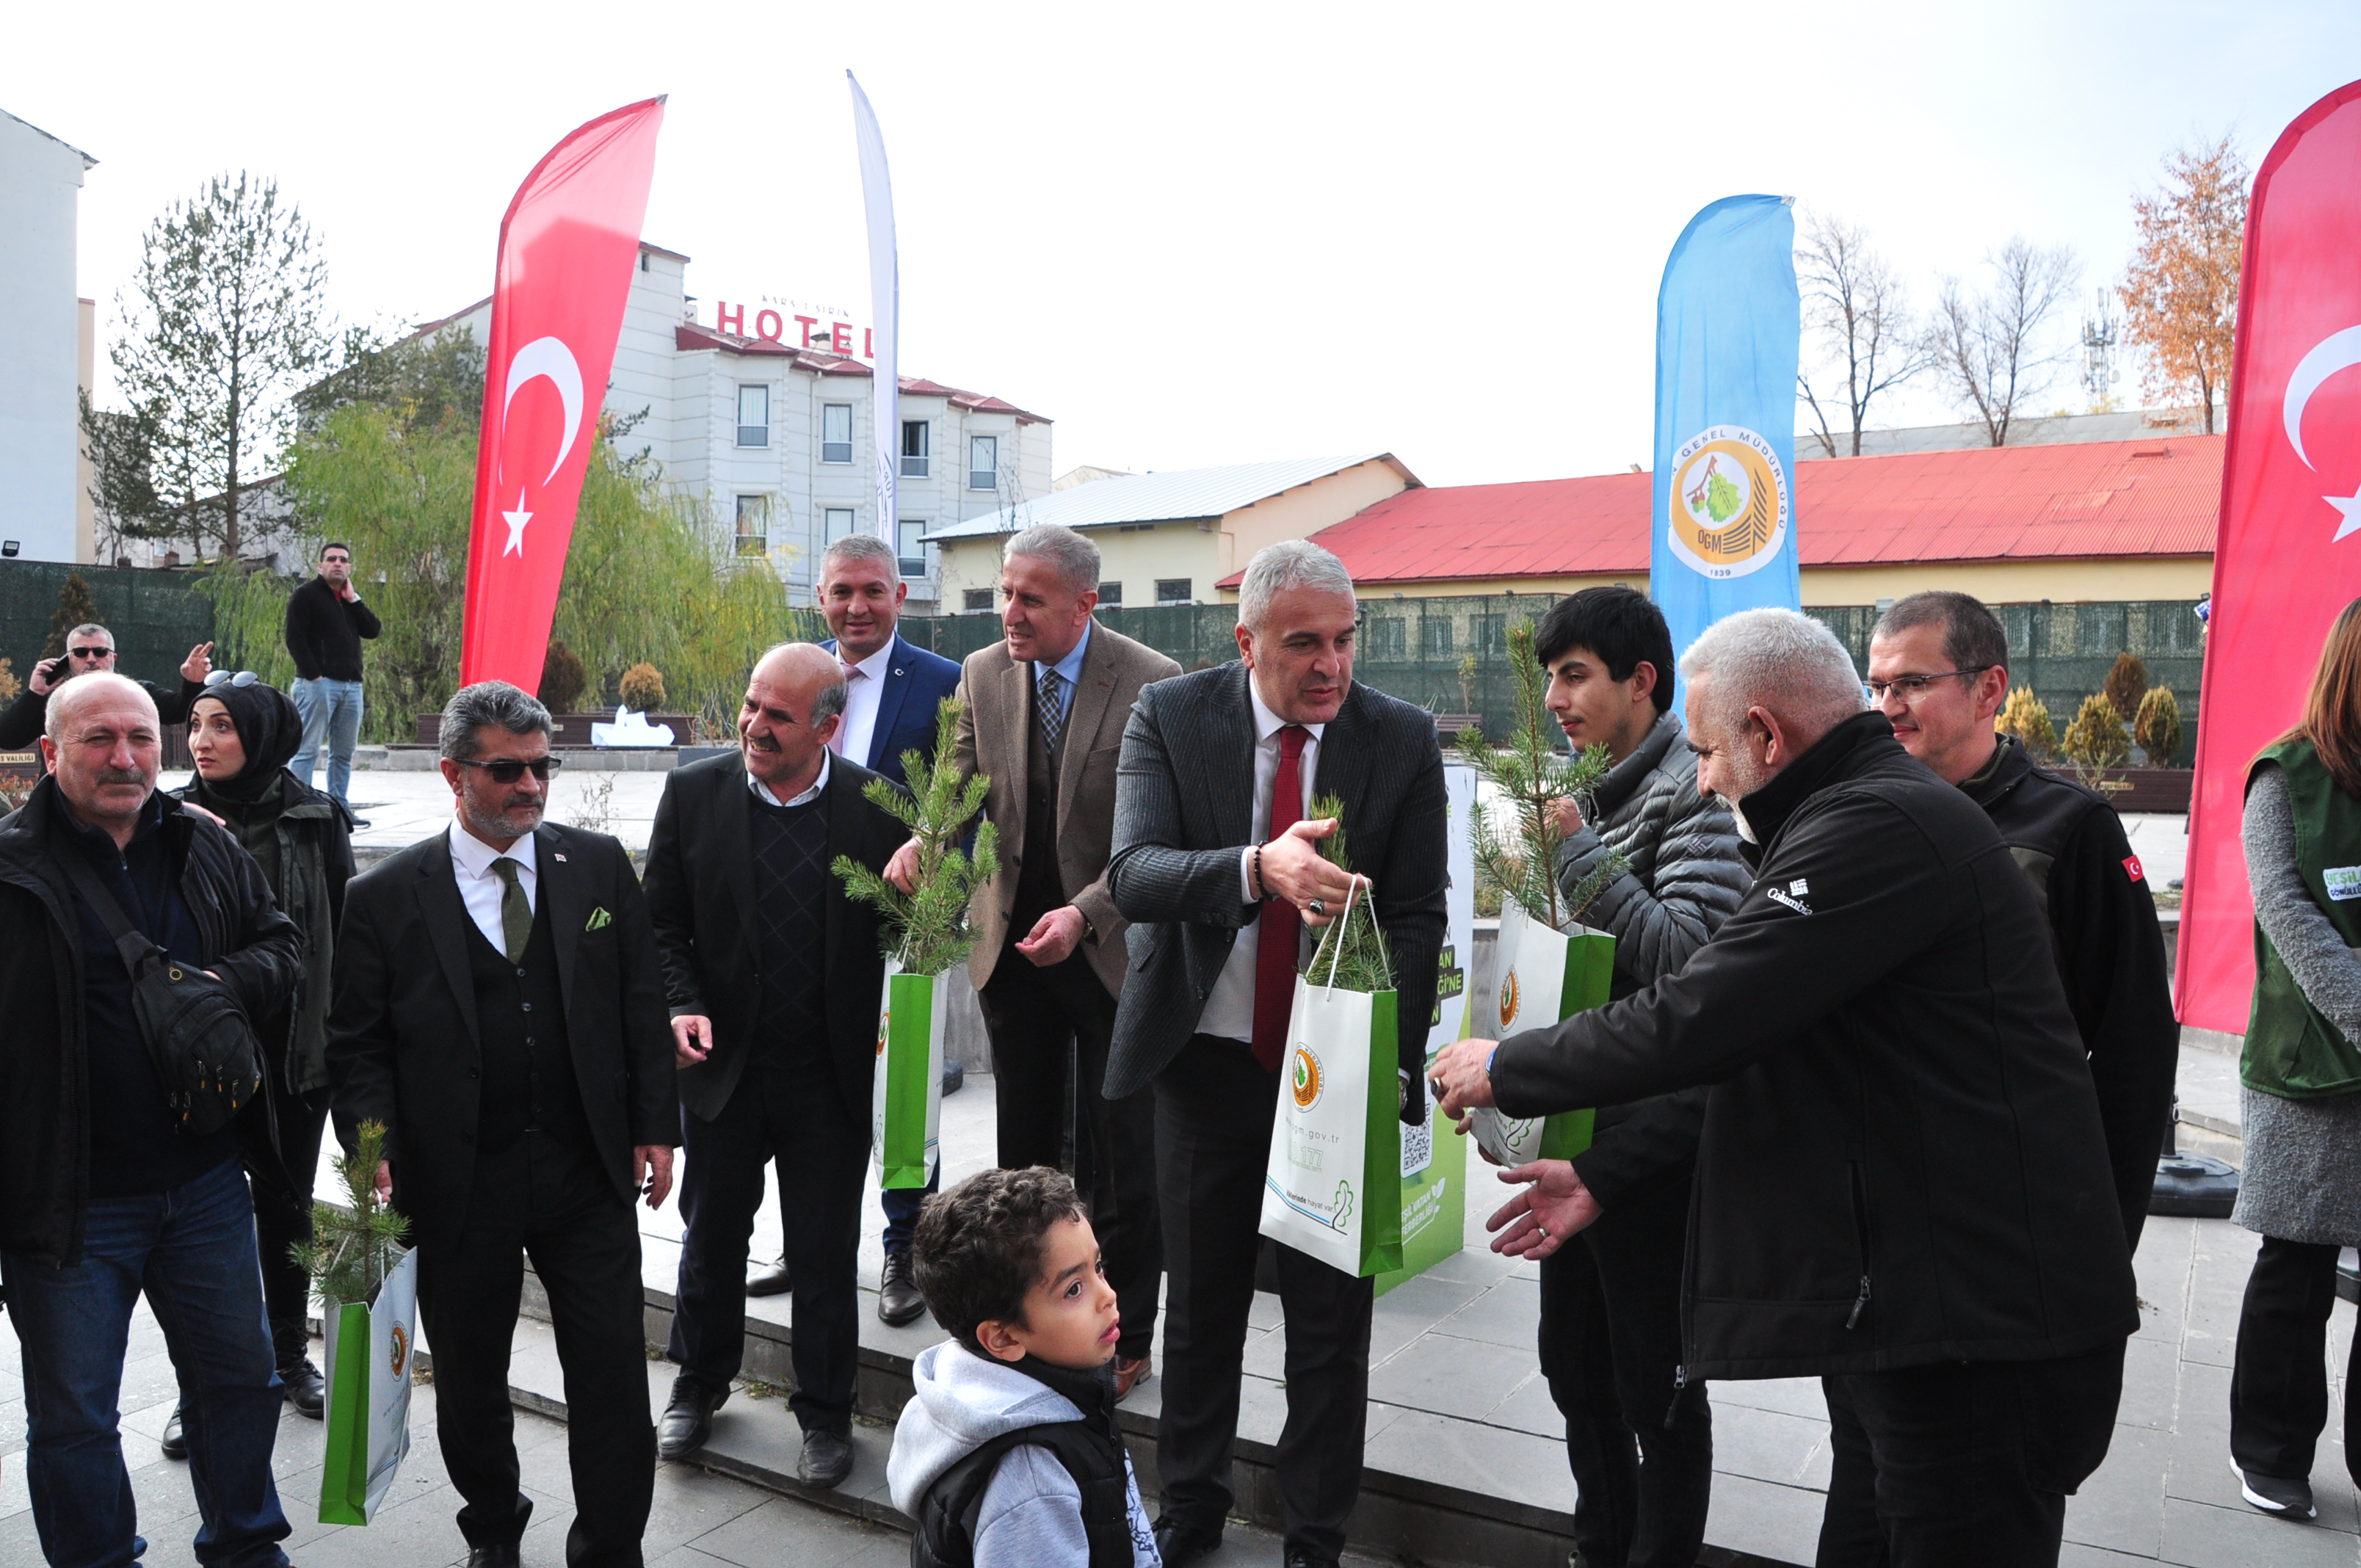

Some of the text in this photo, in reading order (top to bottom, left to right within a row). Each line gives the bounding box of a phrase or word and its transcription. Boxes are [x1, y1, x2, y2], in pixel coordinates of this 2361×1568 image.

[717, 300, 874, 359] HOTEL
[1681, 429, 1726, 458] GENEL
[1698, 529, 1722, 554] OGM
[1767, 888, 1813, 916] Columbia
[1300, 1145, 1324, 1167] 177
